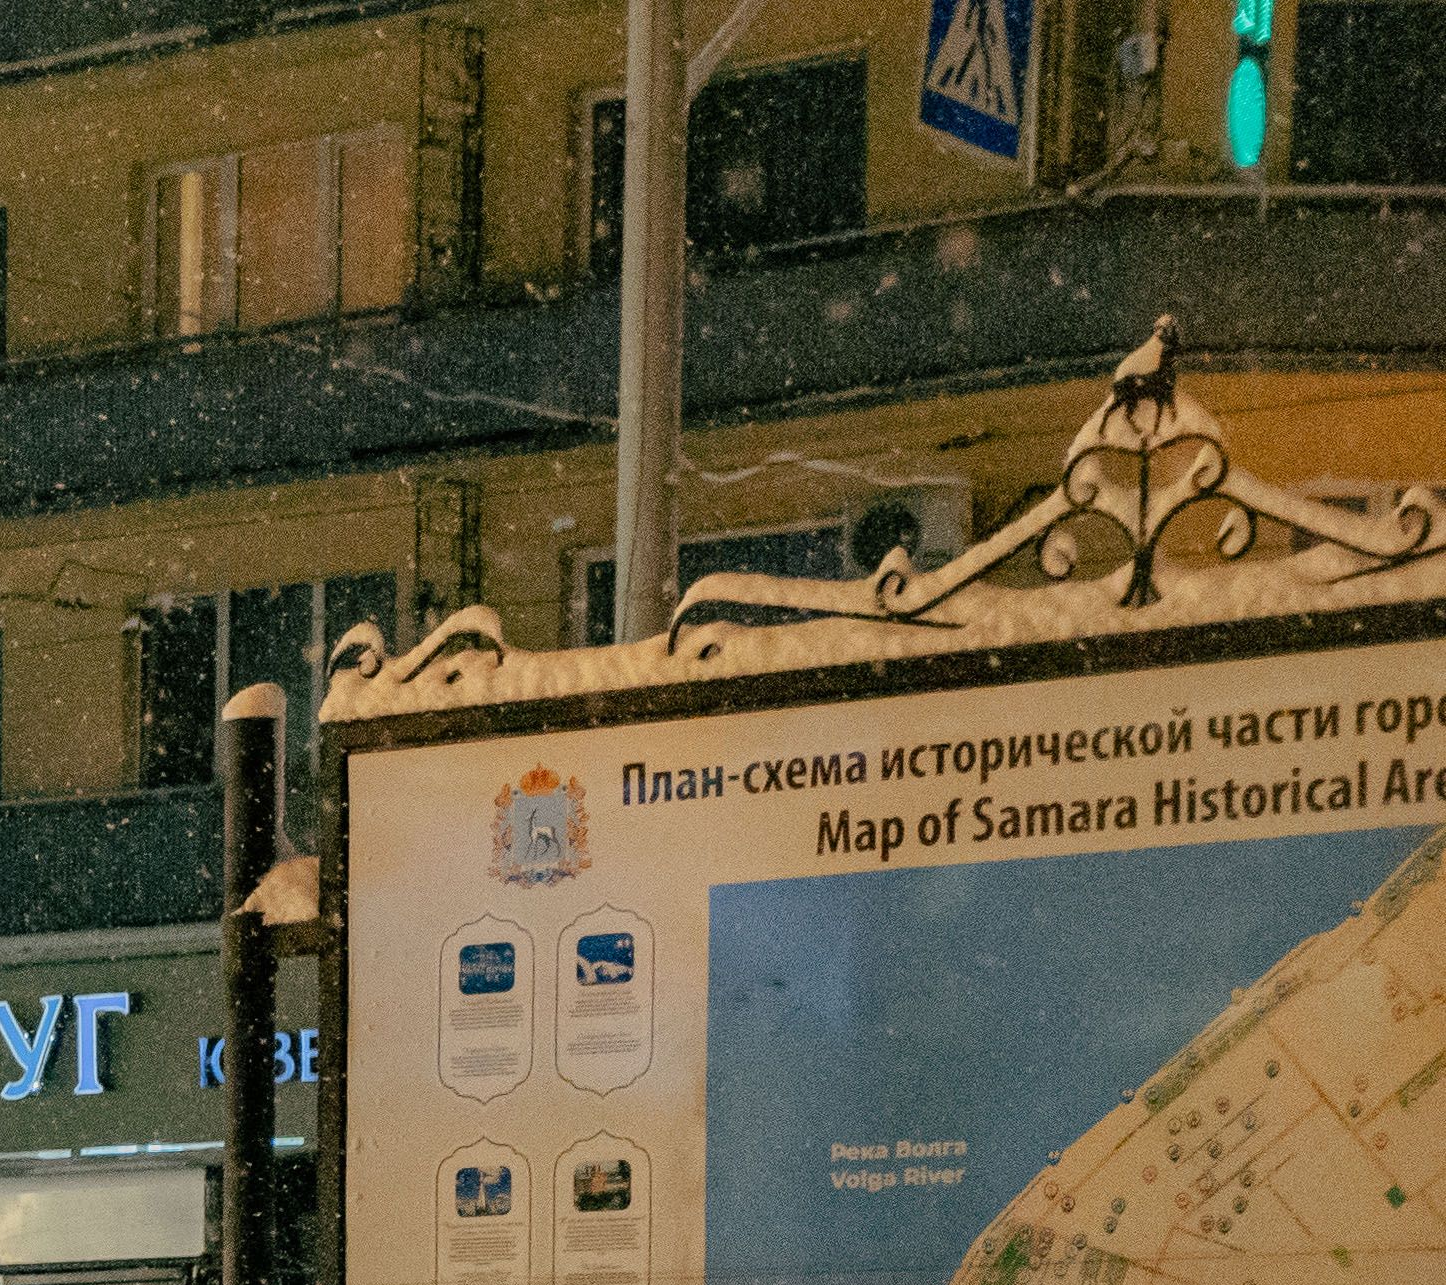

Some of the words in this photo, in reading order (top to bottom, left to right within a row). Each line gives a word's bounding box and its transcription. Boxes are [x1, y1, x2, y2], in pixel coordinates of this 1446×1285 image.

[622, 751, 867, 806] План-схема
[880, 706, 1193, 783] исторической
[1208, 703, 1340, 749] части
[816, 809, 904, 861] Map
[917, 798, 962, 847] of
[971, 796, 1138, 843] Samara
[1154, 759, 1367, 826] Historical
[830, 1142, 889, 1162] Река
[895, 1139, 967, 1159] Волга
[830, 1169, 897, 1193] Volga
[904, 1165, 966, 1186] River
